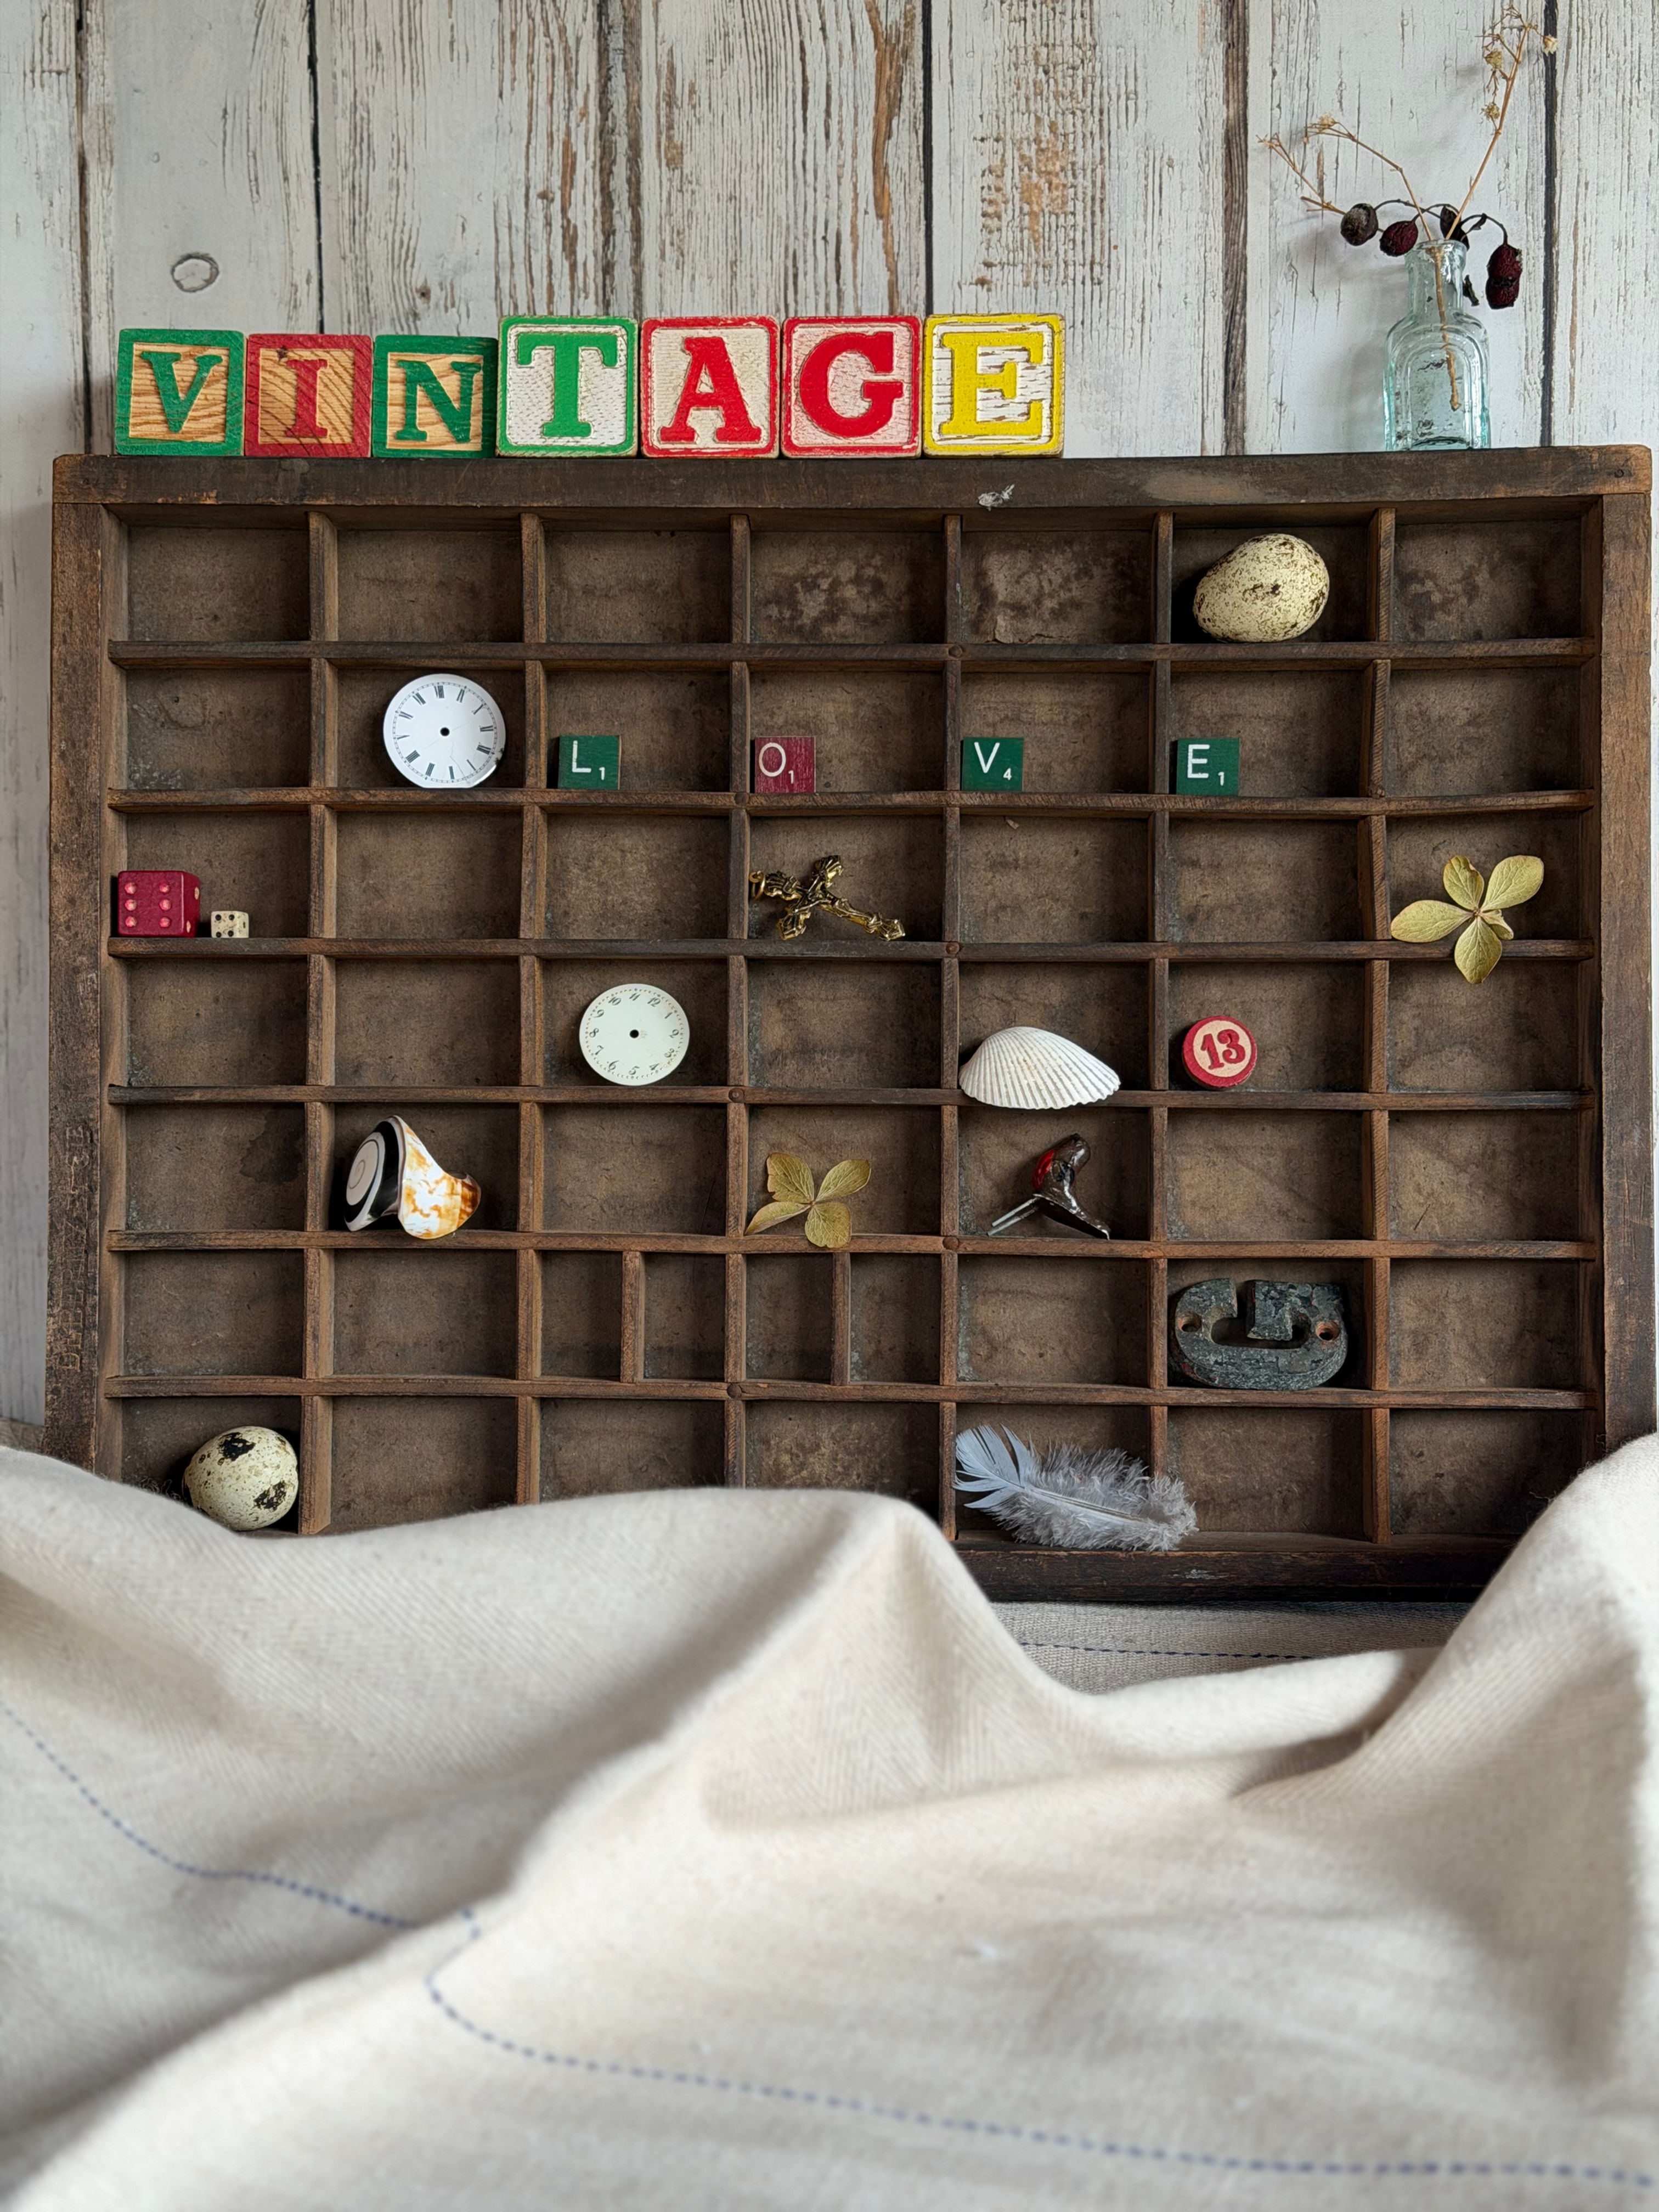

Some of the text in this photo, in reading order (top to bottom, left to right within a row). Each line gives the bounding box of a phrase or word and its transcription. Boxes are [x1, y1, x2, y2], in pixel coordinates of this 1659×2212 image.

[608, 996, 621, 1006] 10
[629, 993, 640, 1001] 11
[647, 997, 661, 1007] 12
[593, 1009, 604, 1018] 9
[589, 1028, 599, 1038] 8
[669, 1029, 679, 1038] 2
[595, 1045, 604, 1055] 7
[664, 1048, 675, 1058] 3
[1200, 1029, 1246, 1070] 13
[629, 1065, 640, 1075] 5
